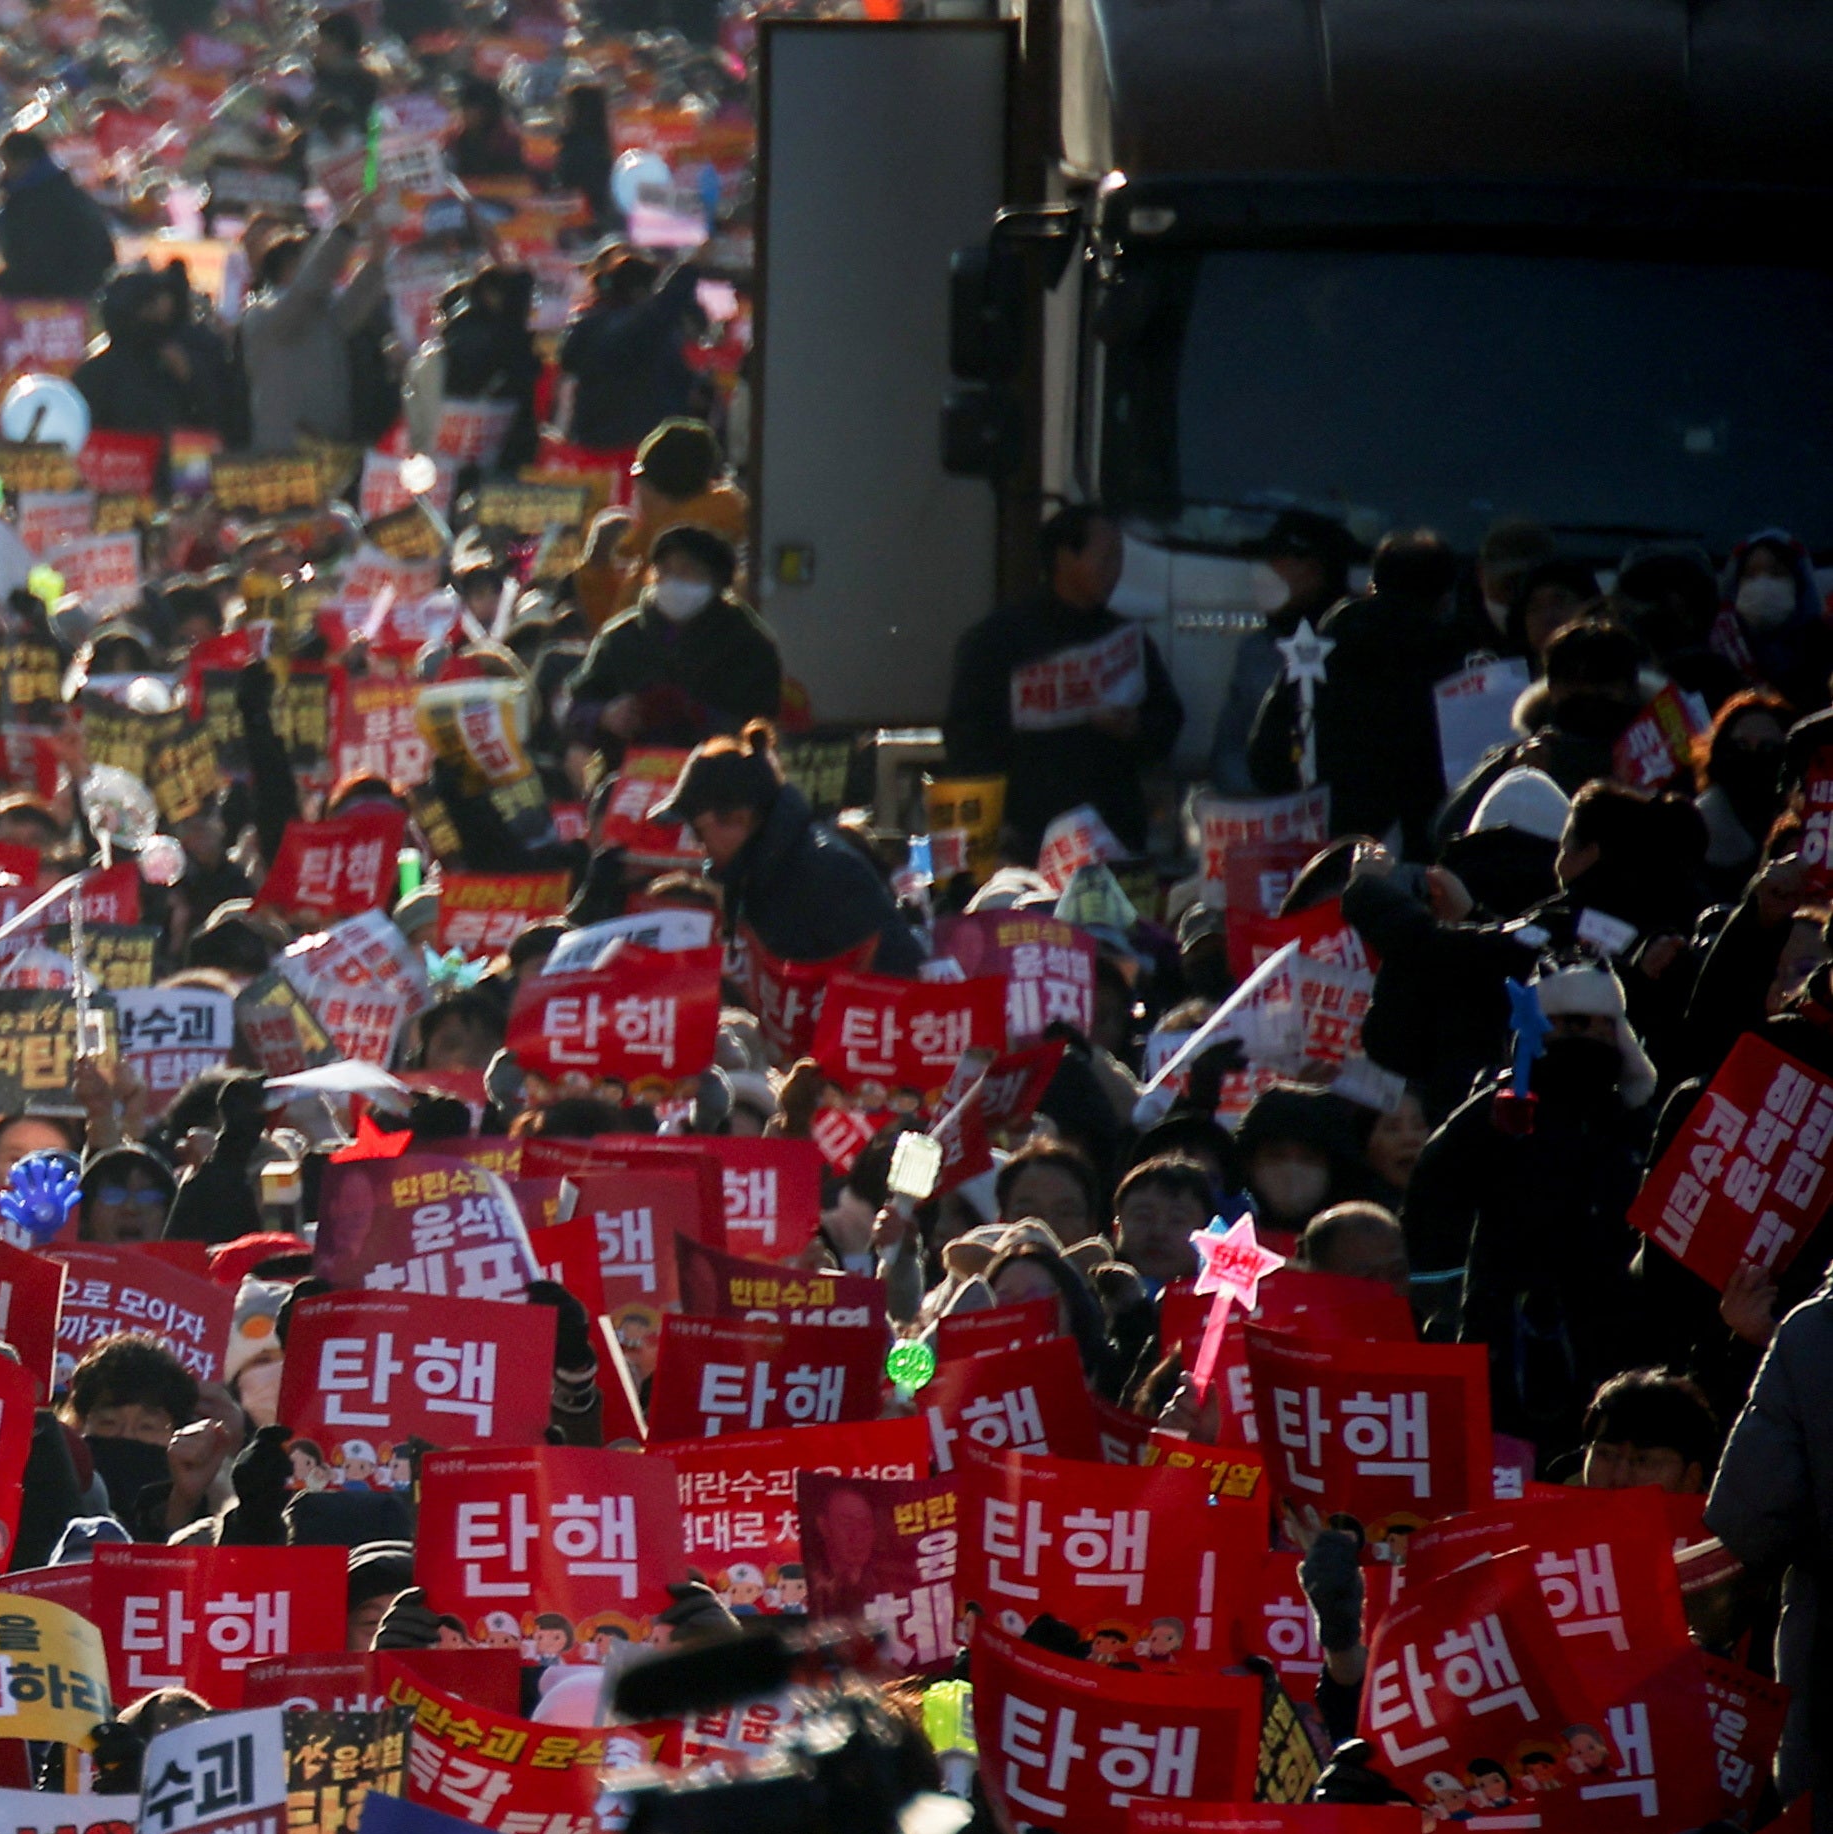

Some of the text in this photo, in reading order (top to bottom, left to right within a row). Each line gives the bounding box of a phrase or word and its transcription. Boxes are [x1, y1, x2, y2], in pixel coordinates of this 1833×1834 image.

[541, 993, 676, 1070] 탄핵
[839, 1006, 973, 1076] 탄핵
[118, 1288, 209, 1342] 모이자
[316, 1332, 499, 1439] 탄핵
[697, 1361, 847, 1439] 탄핵
[1272, 1385, 1432, 1500] 탄핵
[454, 1492, 639, 1601] 탄핵
[982, 1498, 1153, 1608] 탄핵
[120, 1591, 292, 1695] 탄핵
[1368, 1611, 1542, 1769] 탄핵
[388, 1675, 526, 1764] 내란수괴
[999, 1693, 1202, 1817] 탄핵
